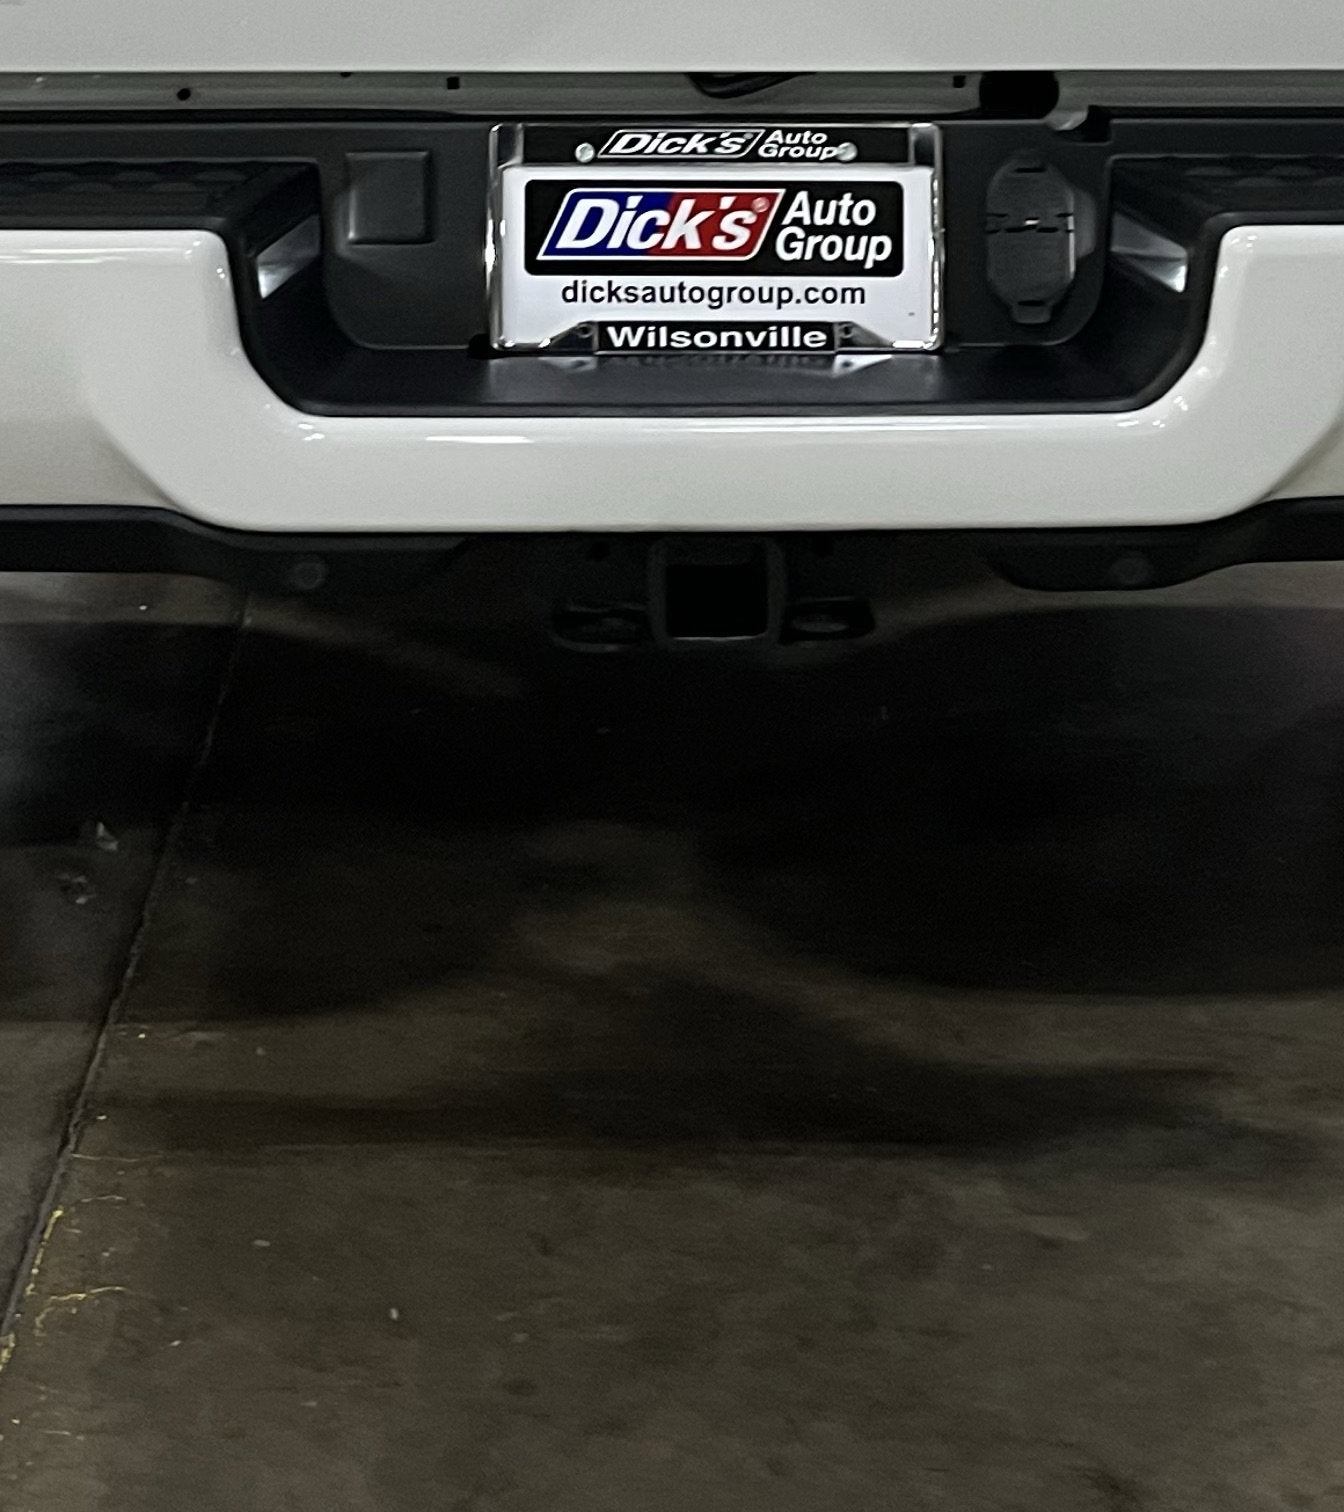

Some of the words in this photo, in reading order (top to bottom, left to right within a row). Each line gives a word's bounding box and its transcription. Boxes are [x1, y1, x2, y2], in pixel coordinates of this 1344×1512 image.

[609, 132, 747, 154] Dick's
[764, 130, 828, 145] Auto
[758, 144, 838, 161] Group
[782, 190, 877, 227] Auto
[555, 195, 760, 250] Dick's
[775, 227, 893, 269] Group
[561, 280, 866, 309] dicksautogroup.com
[606, 325, 828, 349] Wilsonville
